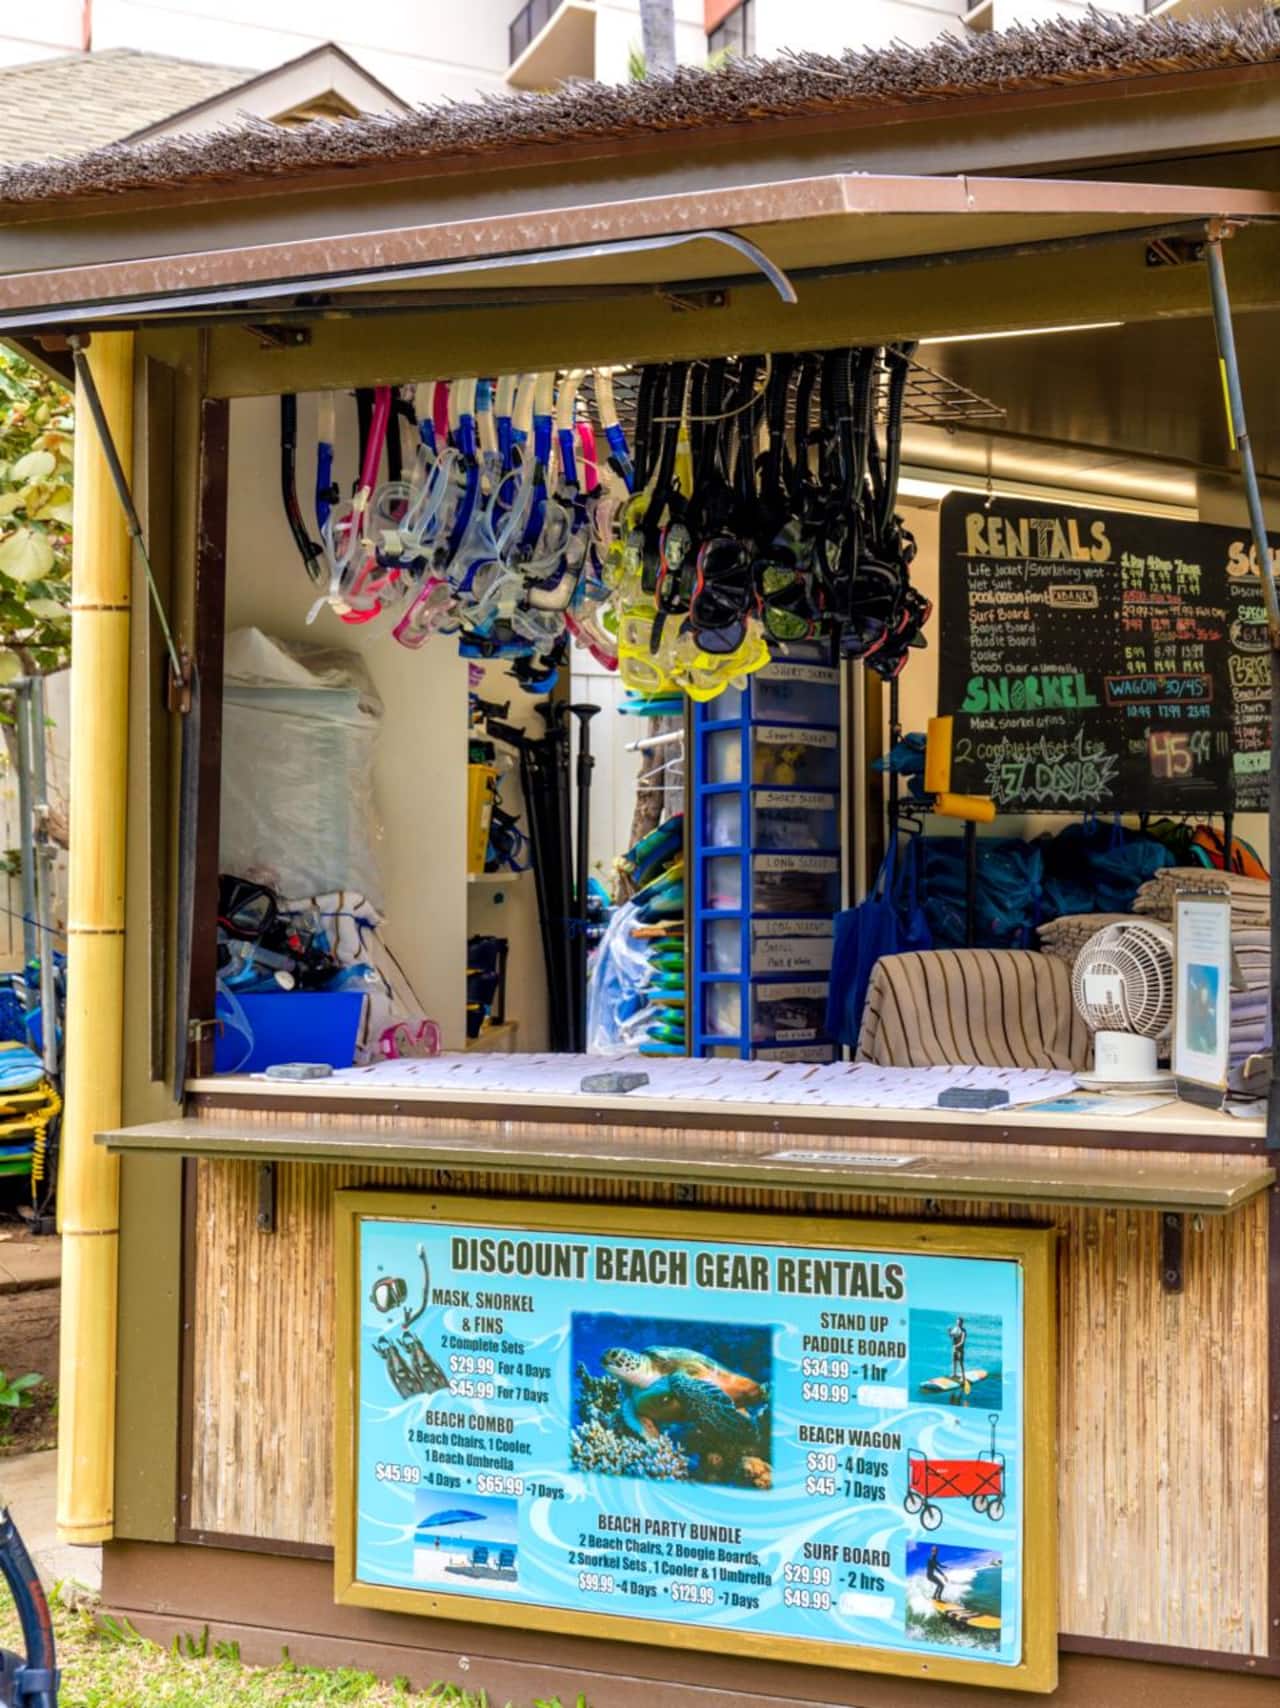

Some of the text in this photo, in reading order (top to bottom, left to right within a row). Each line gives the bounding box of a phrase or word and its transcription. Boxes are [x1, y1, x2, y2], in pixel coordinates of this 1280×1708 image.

[965, 512, 1112, 564] RENTALS
[969, 607, 1031, 622] Surf Board
[962, 673, 1097, 712] SNORKEL
[1109, 679, 1157, 696] WAGON
[1036, 761, 1099, 796] DAYS
[452, 1237, 904, 1300] DISCOUNT BEACH GEAR RENTALS
[476, 1292, 535, 1312] SNORKEL
[462, 1317, 503, 1334] & FINS
[820, 1312, 888, 1333] STAND UP
[441, 1336, 525, 1355] 2 Complete Sets
[803, 1335, 906, 1359] PADDLE BOARD
[450, 1355, 551, 1379] $29.99 For 4 Days
[802, 1356, 888, 1382] $34.99 1 hr
[449, 1378, 549, 1403] $45.99 For 7 Days
[802, 1381, 850, 1404] $49.99
[426, 1410, 514, 1434] BEACH COMBO
[408, 1429, 415, 1441] 2
[416, 1430, 449, 1446] Beach
[450, 1433, 487, 1450] Chairs,
[799, 1425, 901, 1450] BEACH WAGON
[431, 1450, 464, 1466] Beach
[466, 1453, 514, 1472] Umbrella
[845, 1456, 853, 1474] 4
[856, 1457, 888, 1478] Days
[375, 1463, 564, 1500] $45.99 Days $65.99 Days
[844, 1480, 851, 1498] 7
[854, 1481, 886, 1501] Days
[598, 1514, 742, 1545] BEACH PARTY BUNDLE
[579, 1534, 586, 1547] 2
[588, 1534, 623, 1551] Beach
[666, 1544, 673, 1556] 2
[676, 1544, 716, 1562] Boogie
[718, 1549, 761, 1567] Boards,
[803, 1542, 891, 1568] SURF BOARD
[568, 1551, 575, 1565] 2
[577, 1552, 620, 1569] Snorkel
[661, 1562, 699, 1578] Cooler
[701, 1567, 709, 1579] &
[719, 1568, 772, 1587] Umbrella
[783, 1562, 885, 1592] $29.99 2 hrs
[578, 1572, 759, 1609] $99.99 Days $129.99 Days
